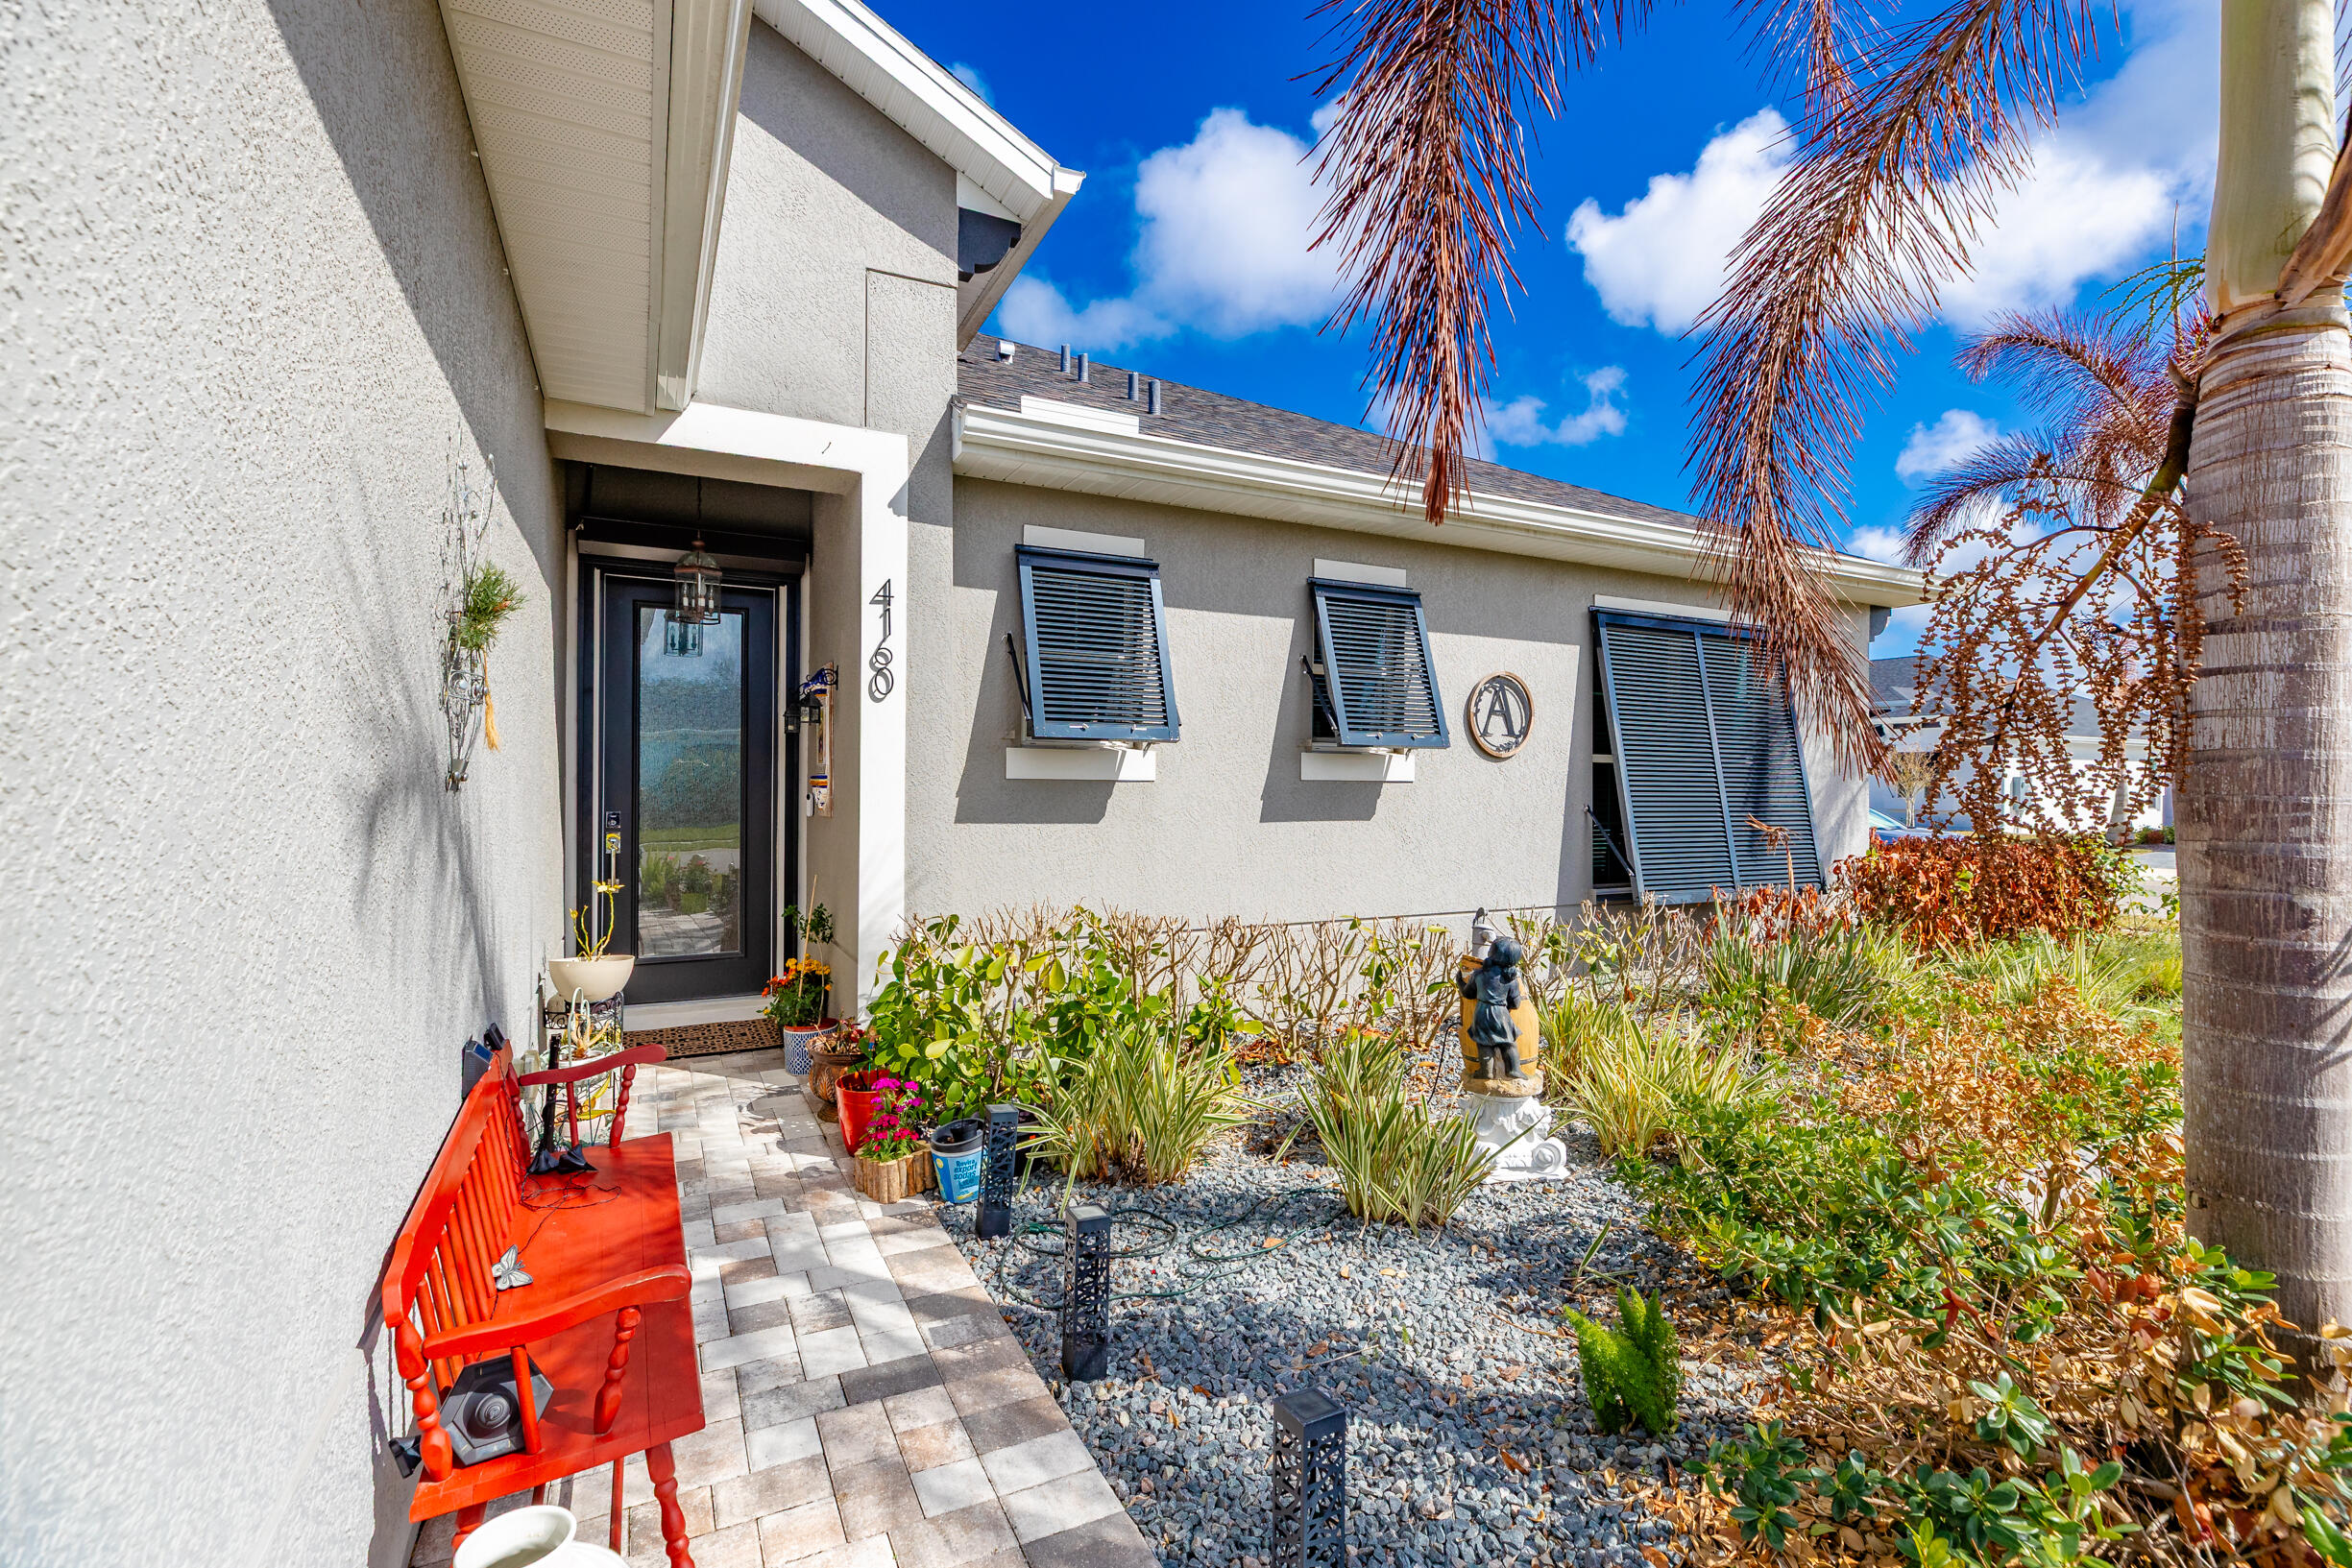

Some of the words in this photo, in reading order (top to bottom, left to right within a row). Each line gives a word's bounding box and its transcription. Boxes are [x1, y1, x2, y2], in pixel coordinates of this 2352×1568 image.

[869, 578, 894, 696] 4160
[1479, 683, 1522, 738] A
[953, 1170, 976, 1180] sodas
[954, 1162, 978, 1173] export
